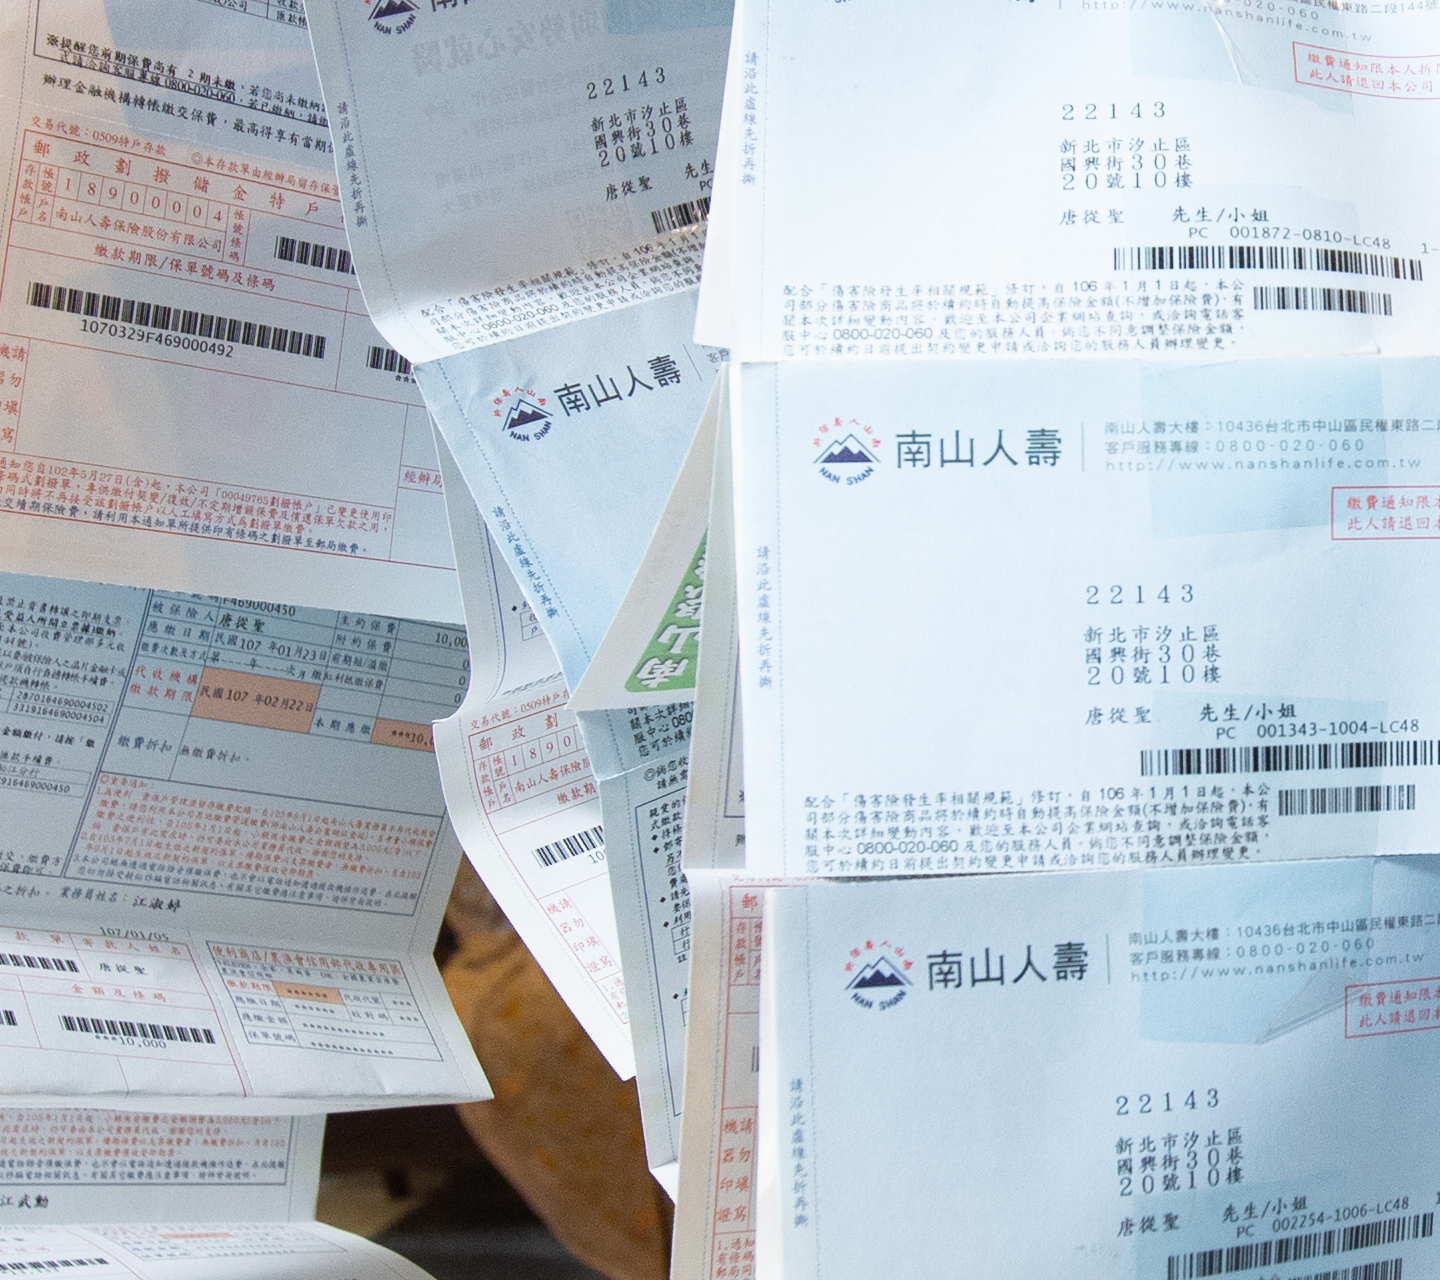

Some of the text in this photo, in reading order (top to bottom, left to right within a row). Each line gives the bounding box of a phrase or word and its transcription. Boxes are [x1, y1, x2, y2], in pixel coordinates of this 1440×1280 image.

[585, 68, 668, 100] 22143
[590, 96, 689, 133] 新北市汐止區
[741, 51, 759, 186] 請沿此虛線先折再撕
[1061, 100, 1167, 122] 22143
[594, 112, 692, 150] 國興街30巷
[1060, 136, 1191, 155] 新北市汐止區
[598, 130, 695, 167] 20號10樓
[1060, 154, 1193, 172] 國興街30巷
[604, 174, 654, 201] 唐從聖
[1061, 171, 1194, 191] 20號10樓
[55, 206, 223, 253] 南山人壽保險股份有限公司
[1060, 206, 1270, 227] 唐從聖 先生/小姐
[1188, 226, 1209, 239] PC
[1229, 225, 1391, 251] 001872-0810-LC48
[94, 242, 276, 292] 繳款期限/保單號碼及條碼
[79, 318, 234, 358] 1070329F469000492
[554, 350, 685, 418] 南山人壽
[895, 427, 1063, 470] 南山人壽
[818, 466, 876, 487] NAN SHAN
[1084, 584, 1195, 605] 22143
[753, 543, 775, 692] 請沿此虛線先折再撕
[1082, 624, 1221, 645] 新北市汐止區
[1084, 644, 1222, 665] 國興街30巷
[1086, 664, 1222, 686] 20號10樓
[1084, 702, 1298, 726] 唐從聖 先生/小姐
[1216, 726, 1236, 740] PC
[1256, 719, 1420, 739] 001343-1004-LC48
[804, 840, 959, 857] 服中心 0800-020-060
[926, 941, 1089, 992] 南山人壽
[1115, 1088, 1220, 1117] 22143
[1115, 1126, 1243, 1157] 新北市汐止區
[1116, 1145, 1245, 1177] 國興街30巷
[1119, 1167, 1245, 1197] 20號10樓
[1116, 1195, 1309, 1238] 唐從聖 先生/小姐
[1236, 1225, 1256, 1240] PC
[1272, 1196, 1411, 1234] 002254-1006-LC48
